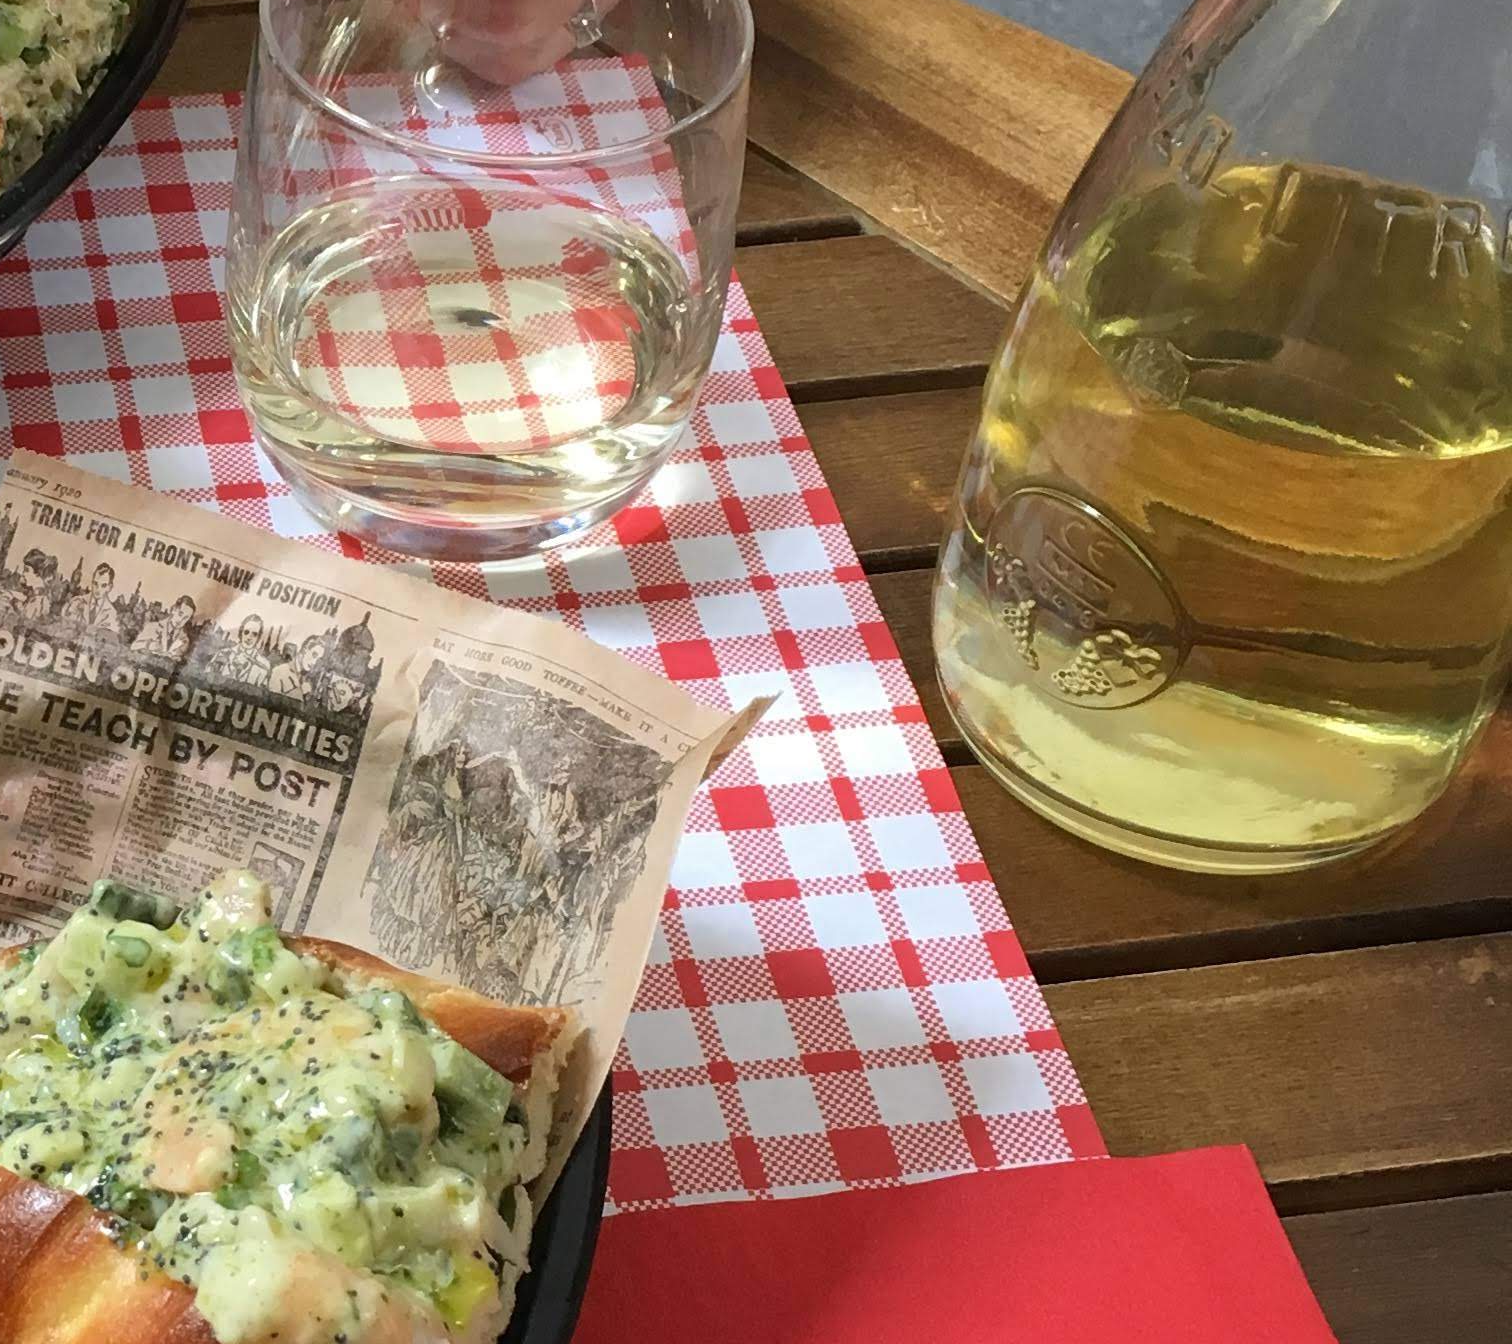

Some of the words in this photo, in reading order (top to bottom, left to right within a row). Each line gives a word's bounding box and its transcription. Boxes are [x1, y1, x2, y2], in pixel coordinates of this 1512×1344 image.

[1256, 159, 1512, 281] LITR
[25, 499, 83, 536] TRAIN
[84, 518, 122, 548] FOR
[120, 531, 139, 554] A
[139, 536, 256, 593] FRONT-RANK
[255, 575, 342, 619] POSITION
[34, 691, 161, 755] TEACH
[165, 729, 220, 774] BY
[225, 749, 332, 811] POST
[500, 653, 533, 673] GOOD
[637, 720, 653, 735] IT
[660, 733, 669, 744] A
